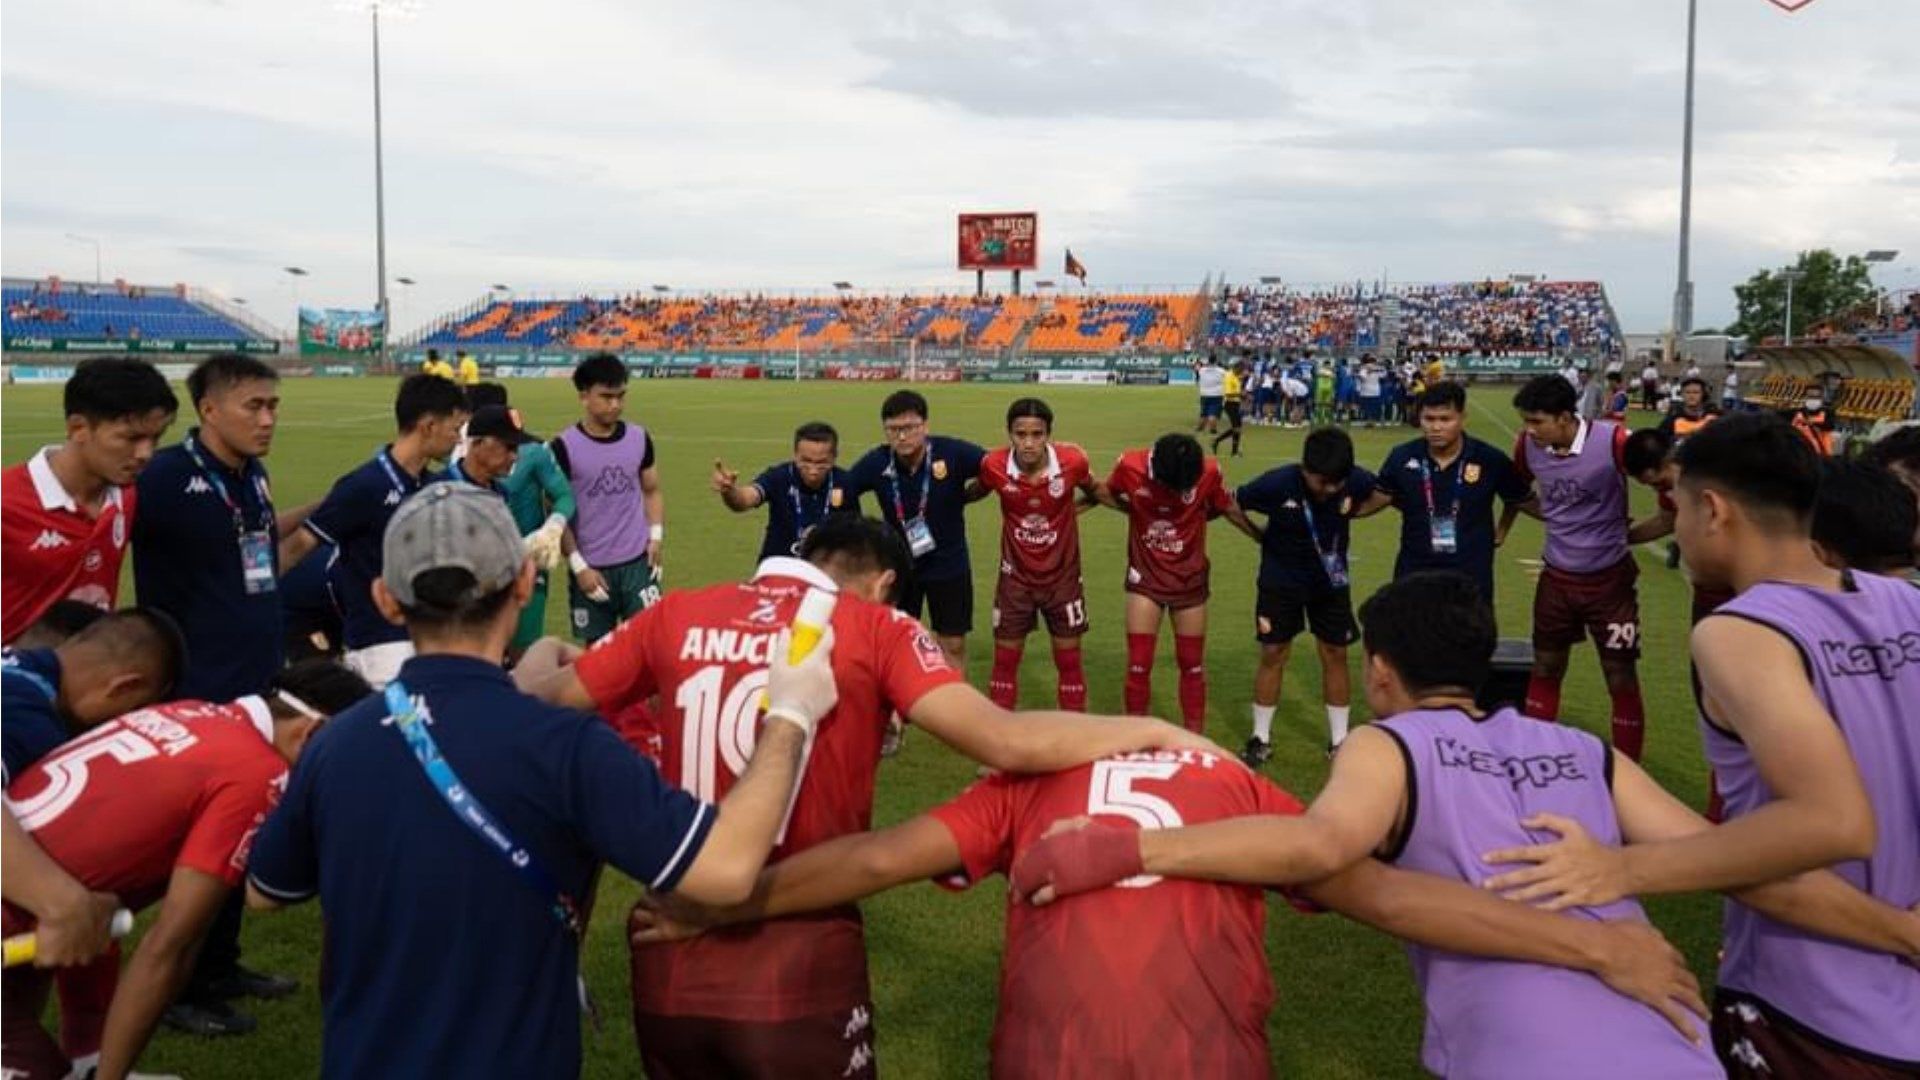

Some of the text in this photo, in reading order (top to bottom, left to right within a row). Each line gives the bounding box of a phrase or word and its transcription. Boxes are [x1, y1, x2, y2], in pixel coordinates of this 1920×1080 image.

[1066, 599, 1084, 627] 13
[1606, 622, 1636, 650] 29
[1434, 736, 1587, 792] Kappa
